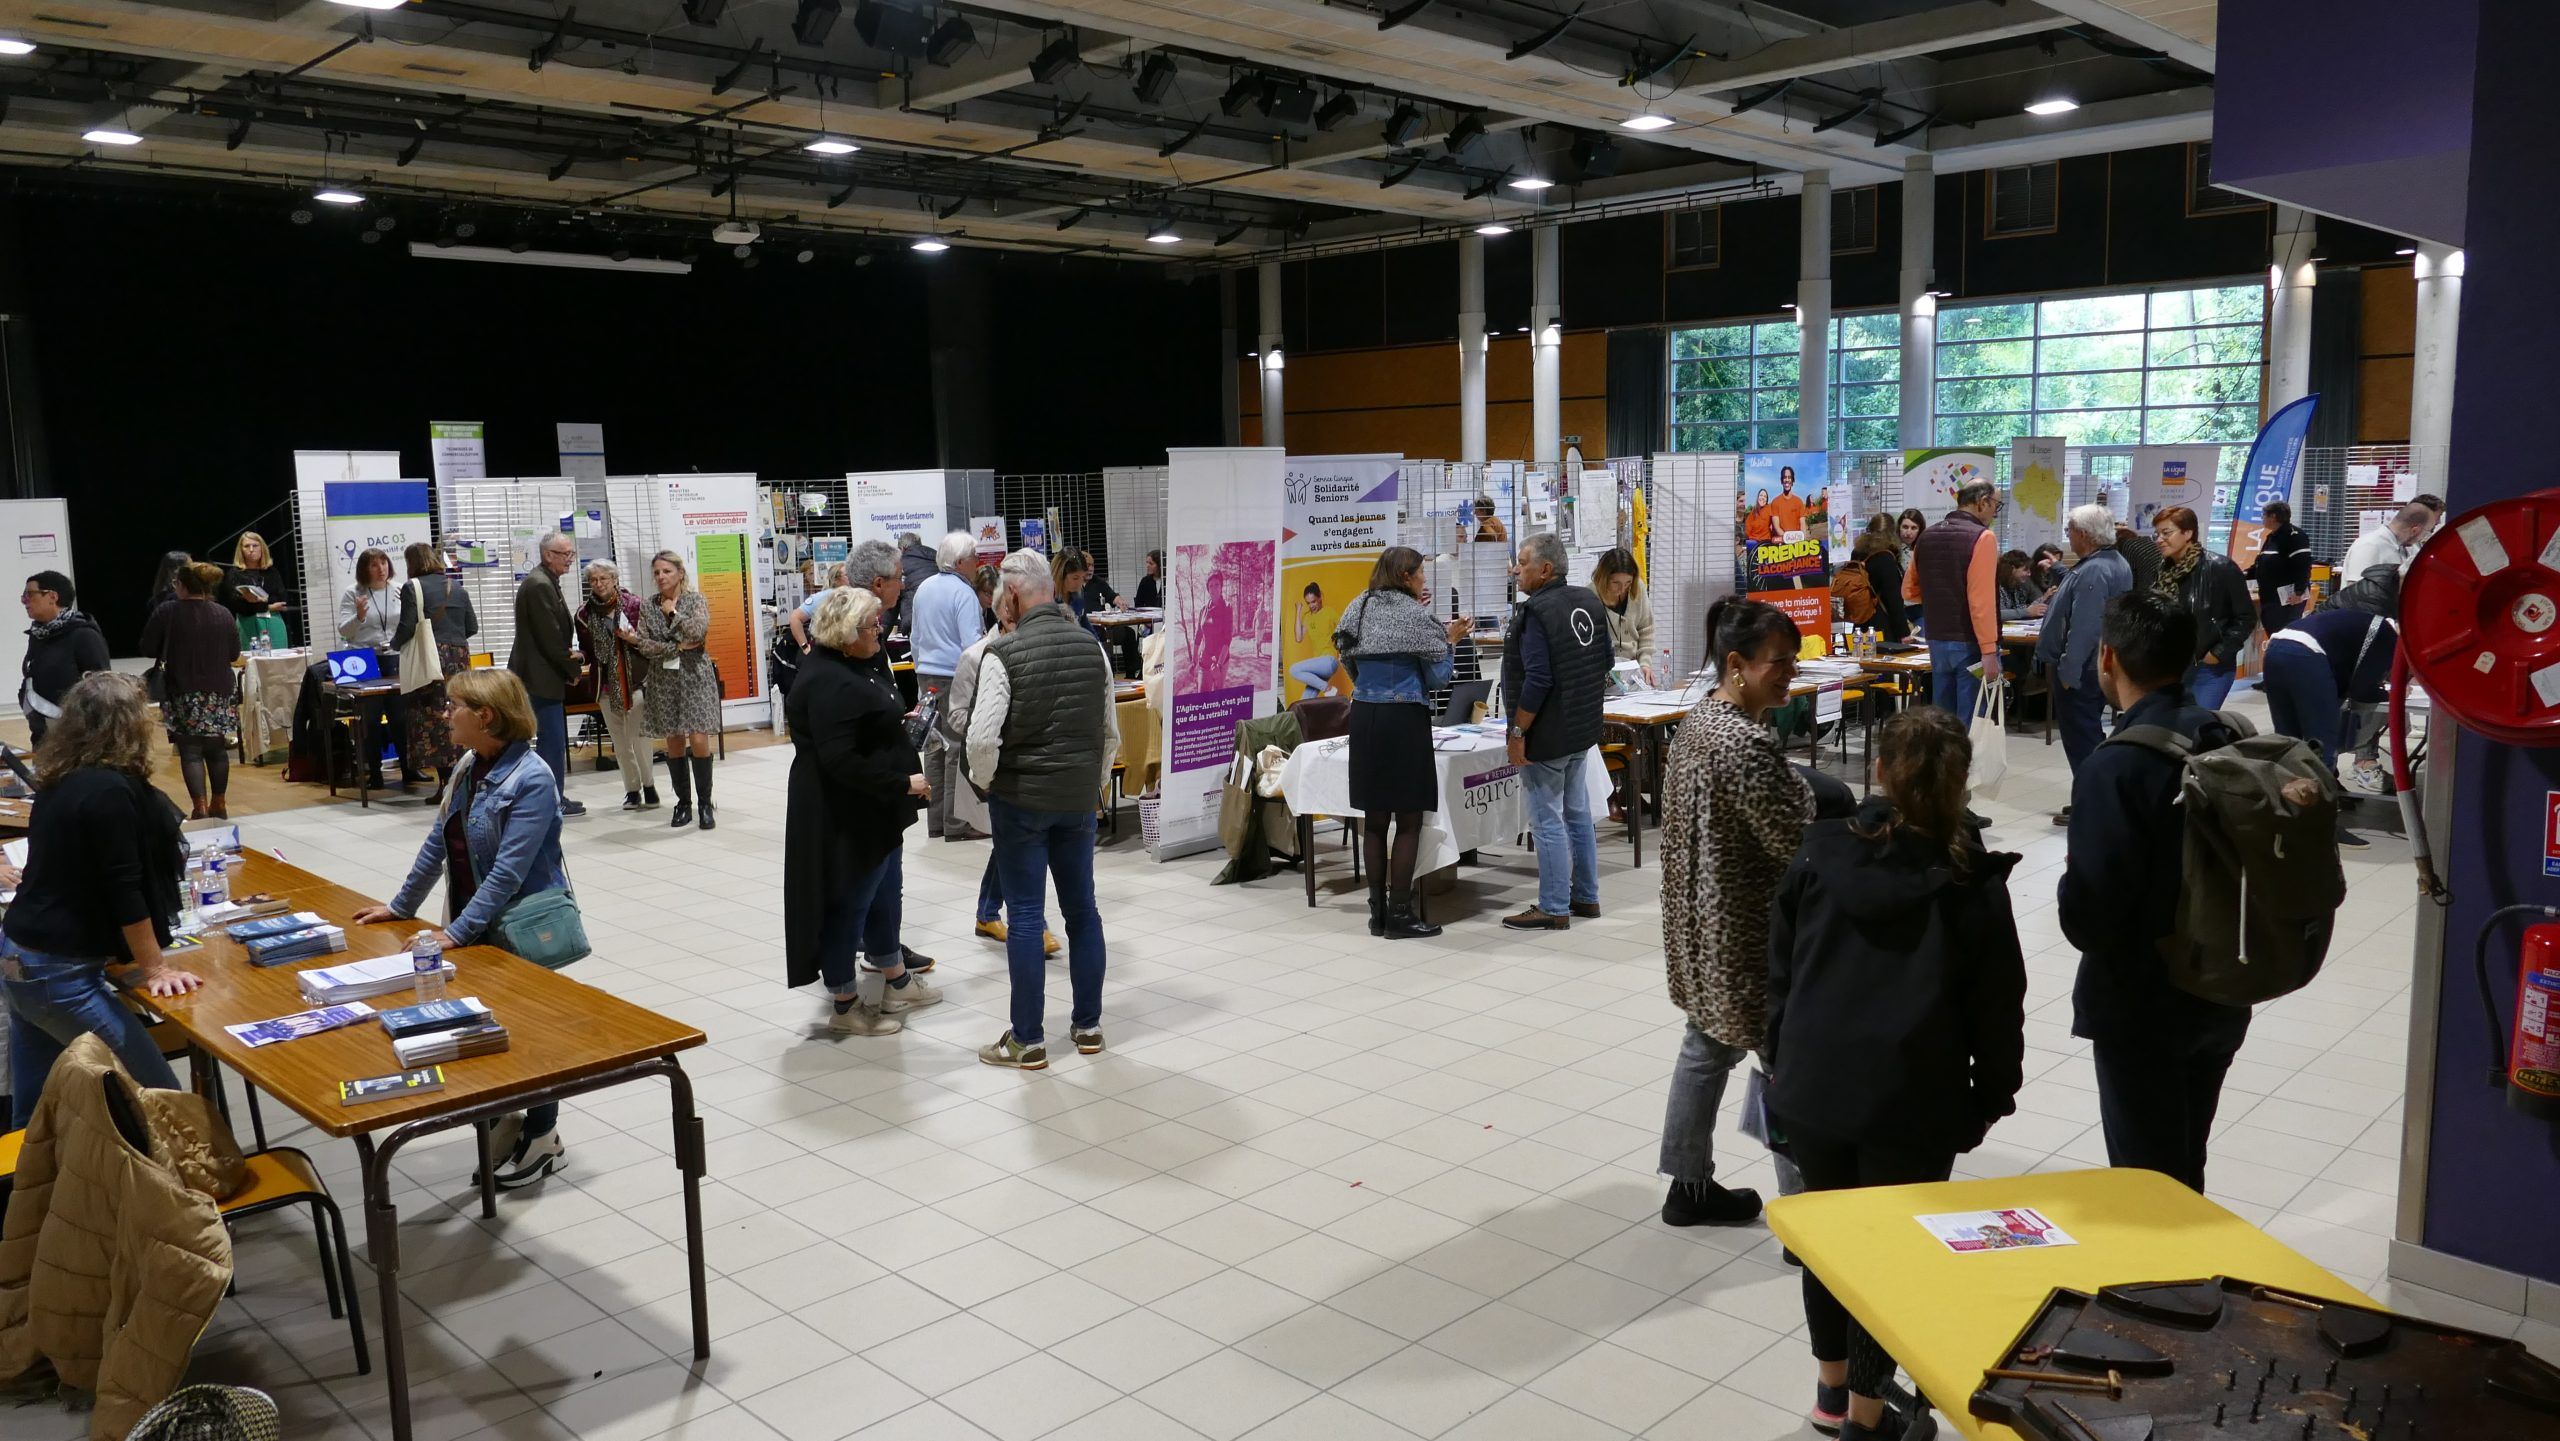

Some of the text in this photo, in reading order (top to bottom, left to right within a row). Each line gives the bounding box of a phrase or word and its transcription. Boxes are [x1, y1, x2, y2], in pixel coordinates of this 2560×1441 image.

[2171, 467, 2185, 476] LIGUE
[1314, 483, 1360, 493] Solidarité
[1315, 494, 1349, 503] Seniors
[2245, 464, 2283, 551] LA LIGUE
[871, 514, 898, 522] Groupement
[906, 512, 934, 520] Gendarmerie
[1308, 513, 1386, 525] Quand les jeunes
[886, 523, 921, 531] Départementale
[1324, 526, 1373, 537] s'engagent
[367, 534, 406, 547] DAC 03
[1310, 539, 1386, 552] auprès des aînés
[1758, 540, 1820, 564] PRENDS
[1786, 599, 1793, 607] ta
[1794, 596, 1819, 606] mission
[1794, 608, 1817, 618] civique
[1222, 698, 1236, 706] c'est
[1237, 696, 1250, 706] plus
[1176, 718, 1187, 726] que
[1189, 714, 1198, 722] de
[1206, 710, 1229, 720] retraite
[1464, 779, 1520, 815] agirc-
